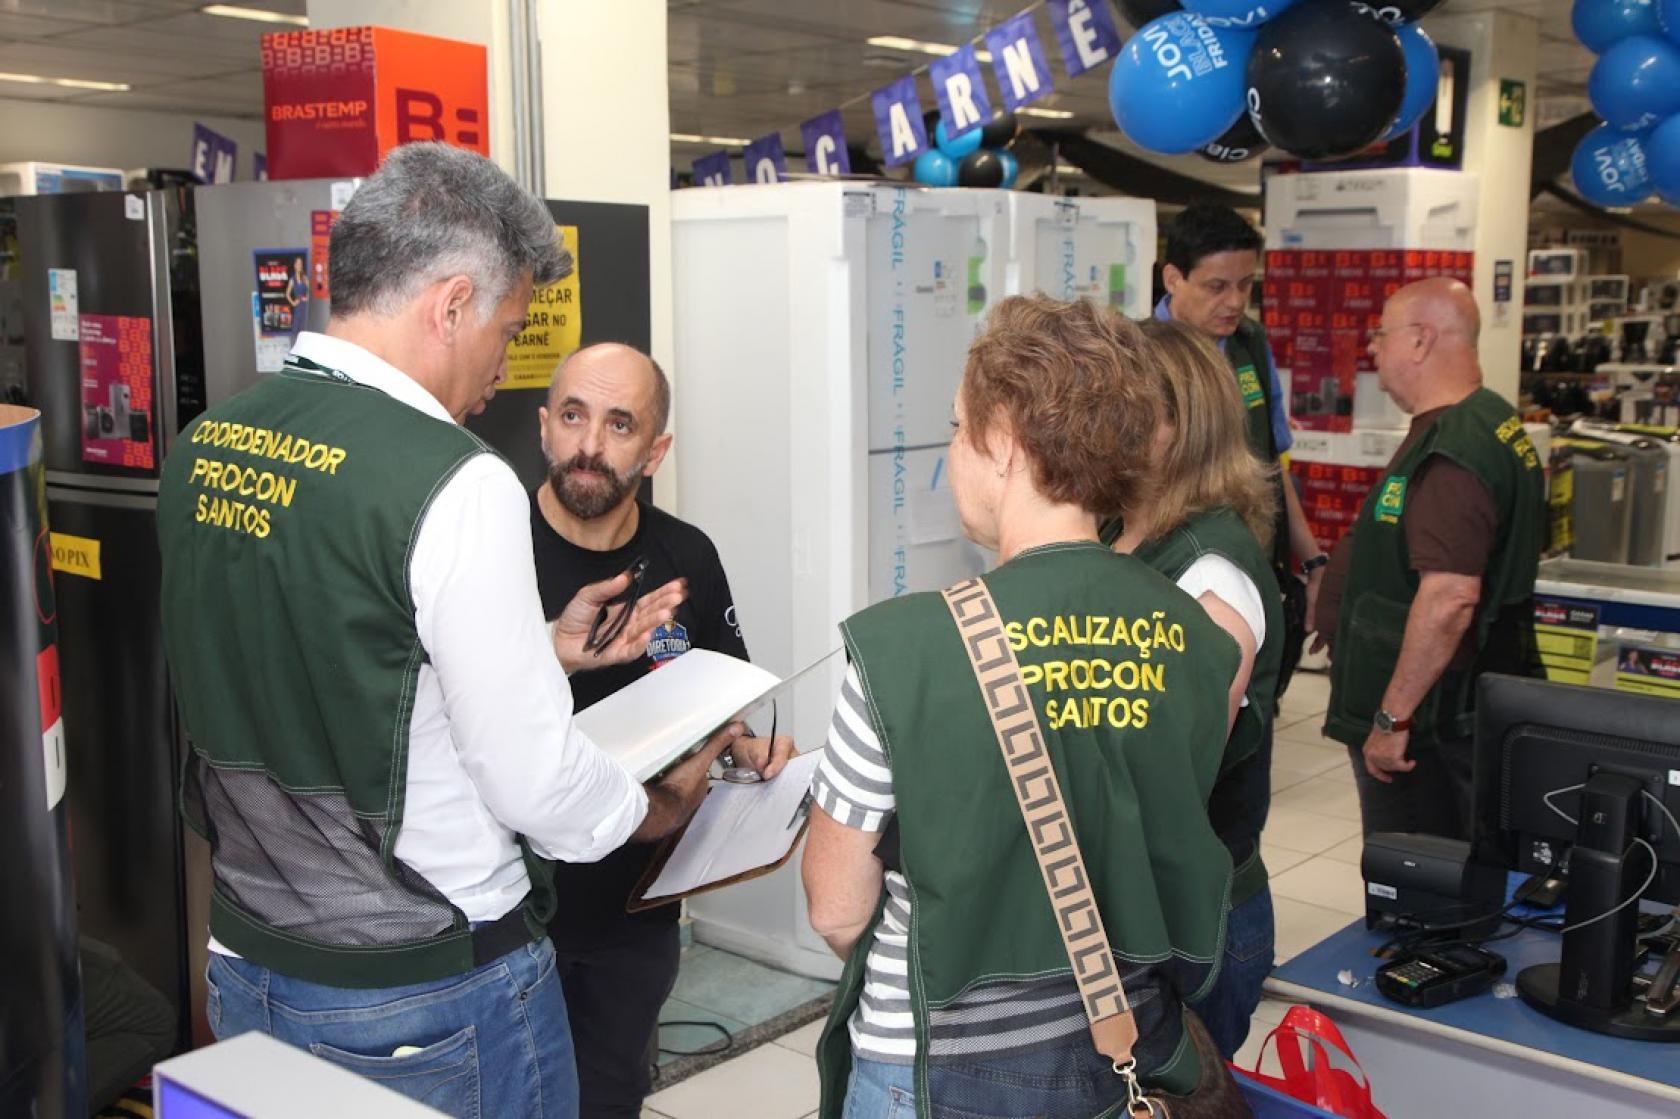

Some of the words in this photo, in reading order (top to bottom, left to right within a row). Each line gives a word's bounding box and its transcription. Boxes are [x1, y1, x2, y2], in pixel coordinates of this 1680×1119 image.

[1142, 25, 1192, 80] JOVI
[272, 101, 367, 121] BRASTEMP
[552, 314, 567, 327] NO
[191, 420, 347, 475] COORDENADOR
[188, 458, 297, 508] PROCON
[195, 493, 271, 538] SANTOS
[67, 549, 90, 568] PIX
[1020, 658, 1166, 692] PROCON
[1044, 697, 1150, 731] SANTOS
